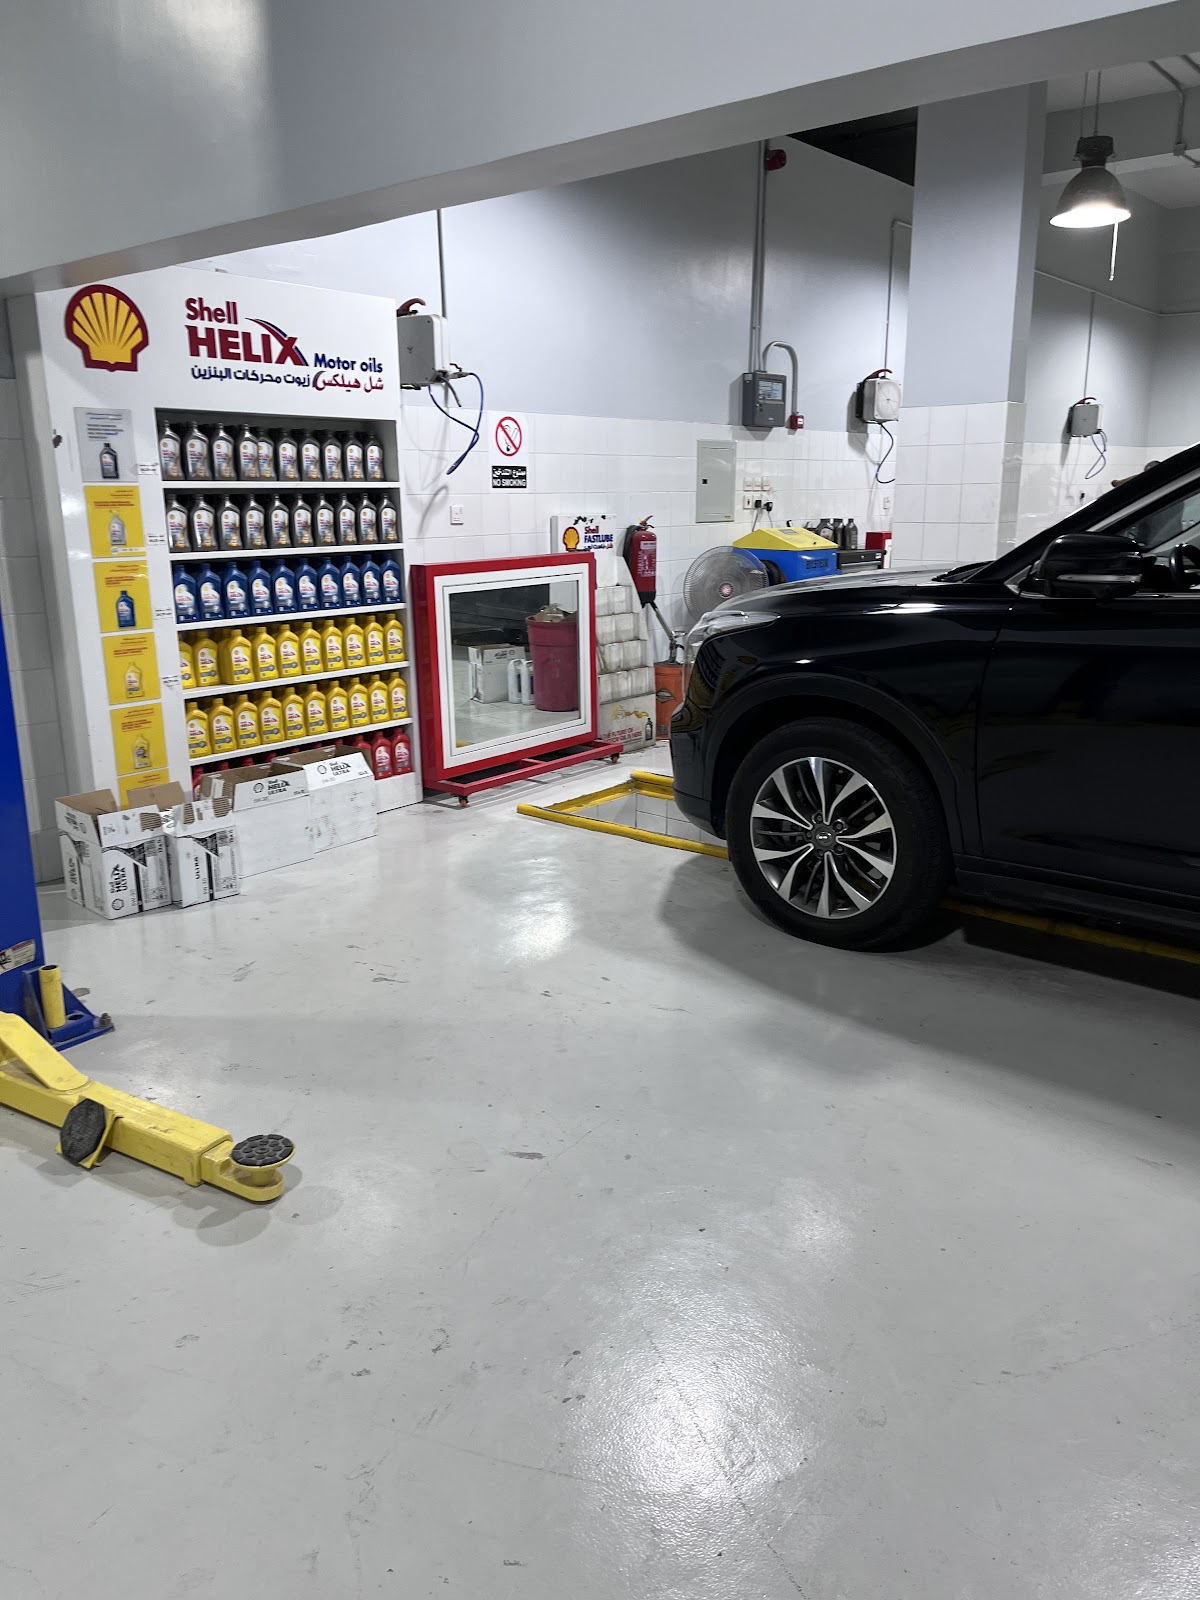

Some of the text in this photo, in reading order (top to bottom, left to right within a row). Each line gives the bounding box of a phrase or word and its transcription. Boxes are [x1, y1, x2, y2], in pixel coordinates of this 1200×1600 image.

[185, 297, 238, 325] Shell
[184, 318, 309, 367] HELIX
[314, 353, 383, 373] Motor oils
[191, 365, 384, 393] شل هيلكس زيوت محركات البنزين
[492, 479, 526, 487] NO SMOKING
[584, 525, 599, 534] Shell
[584, 534, 613, 543] FASTLUBE
